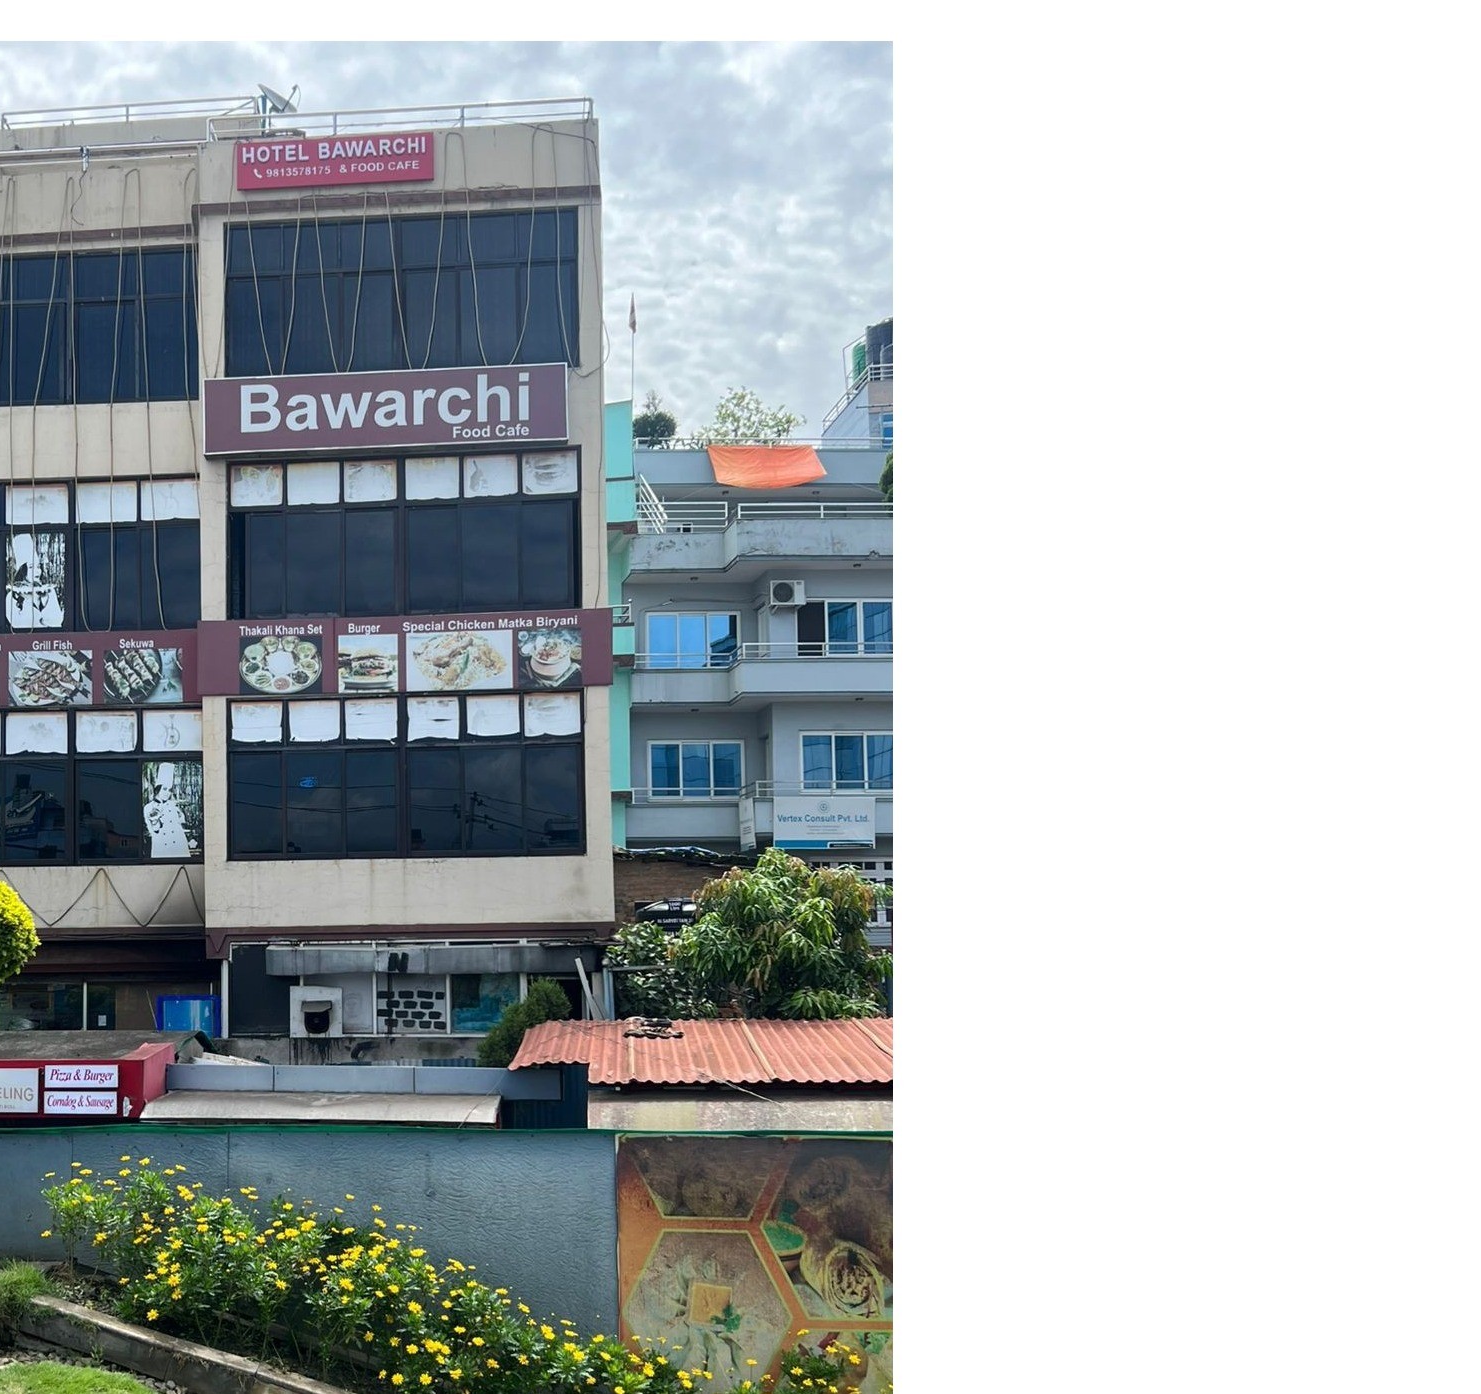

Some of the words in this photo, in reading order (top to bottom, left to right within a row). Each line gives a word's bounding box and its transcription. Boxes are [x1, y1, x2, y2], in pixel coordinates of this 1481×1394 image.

[242, 144, 309, 164] HOTEL
[318, 136, 426, 160] BAWARCHI
[266, 166, 331, 178] 9813578175
[339, 164, 347, 173] &
[351, 162, 384, 172] FOOD
[388, 160, 420, 170] CAFE
[240, 372, 530, 433] Bawarchi
[452, 425, 491, 438] Food
[495, 424, 530, 437] Cafe
[239, 625, 273, 636] Thakali
[275, 624, 305, 635] Khana
[307, 624, 323, 634] Set
[348, 623, 380, 635] Burger
[402, 620, 444, 633] Special
[447, 618, 495, 631] Chicken
[498, 617, 532, 629] Matka
[536, 614, 578, 628] Biryani
[32, 640, 51, 650] Grill
[53, 640, 73, 650] Fish
[119, 638, 154, 649] Sekuwa
[777, 814, 802, 822] Vertex
[804, 814, 835, 822] Consult
[838, 814, 852, 822] Pvt.
[855, 814, 869, 822] Ltd.
[50, 1069, 72, 1081] Pizza
[73, 1069, 81, 1080] &
[84, 1069, 114, 1084] Burger
[47, 1095, 76, 1110] Corndog
[78, 1095, 84, 1107] &
[86, 1095, 114, 1110] Sausage
